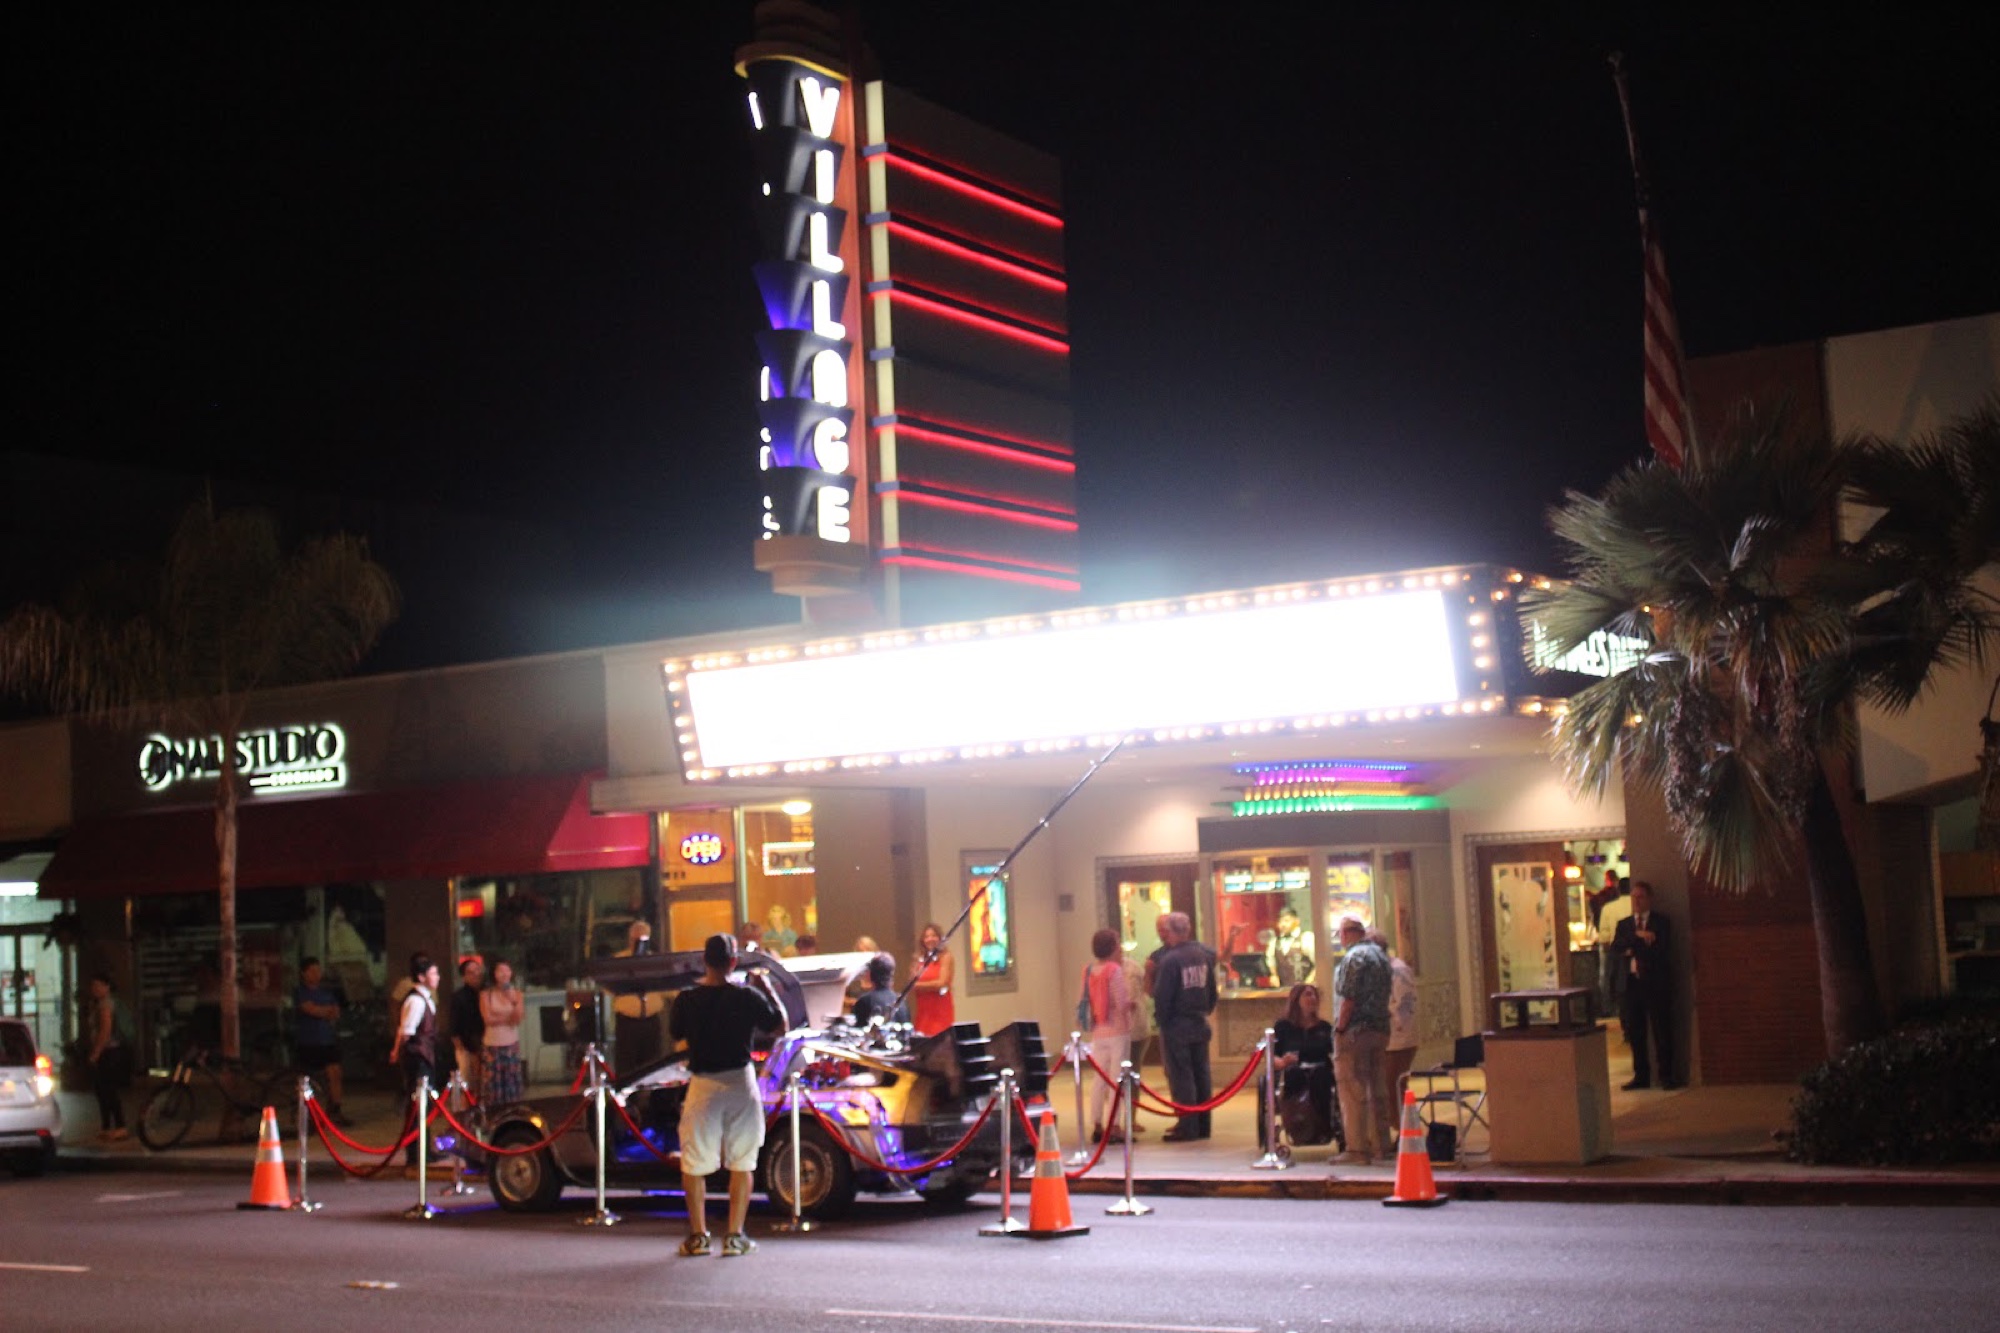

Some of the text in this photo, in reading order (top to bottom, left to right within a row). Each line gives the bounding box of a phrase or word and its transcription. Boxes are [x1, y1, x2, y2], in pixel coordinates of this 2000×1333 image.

[800, 76, 850, 543] VILLAGE
[234, 723, 345, 773] STUDIO
[681, 841, 721, 859] OPEN
